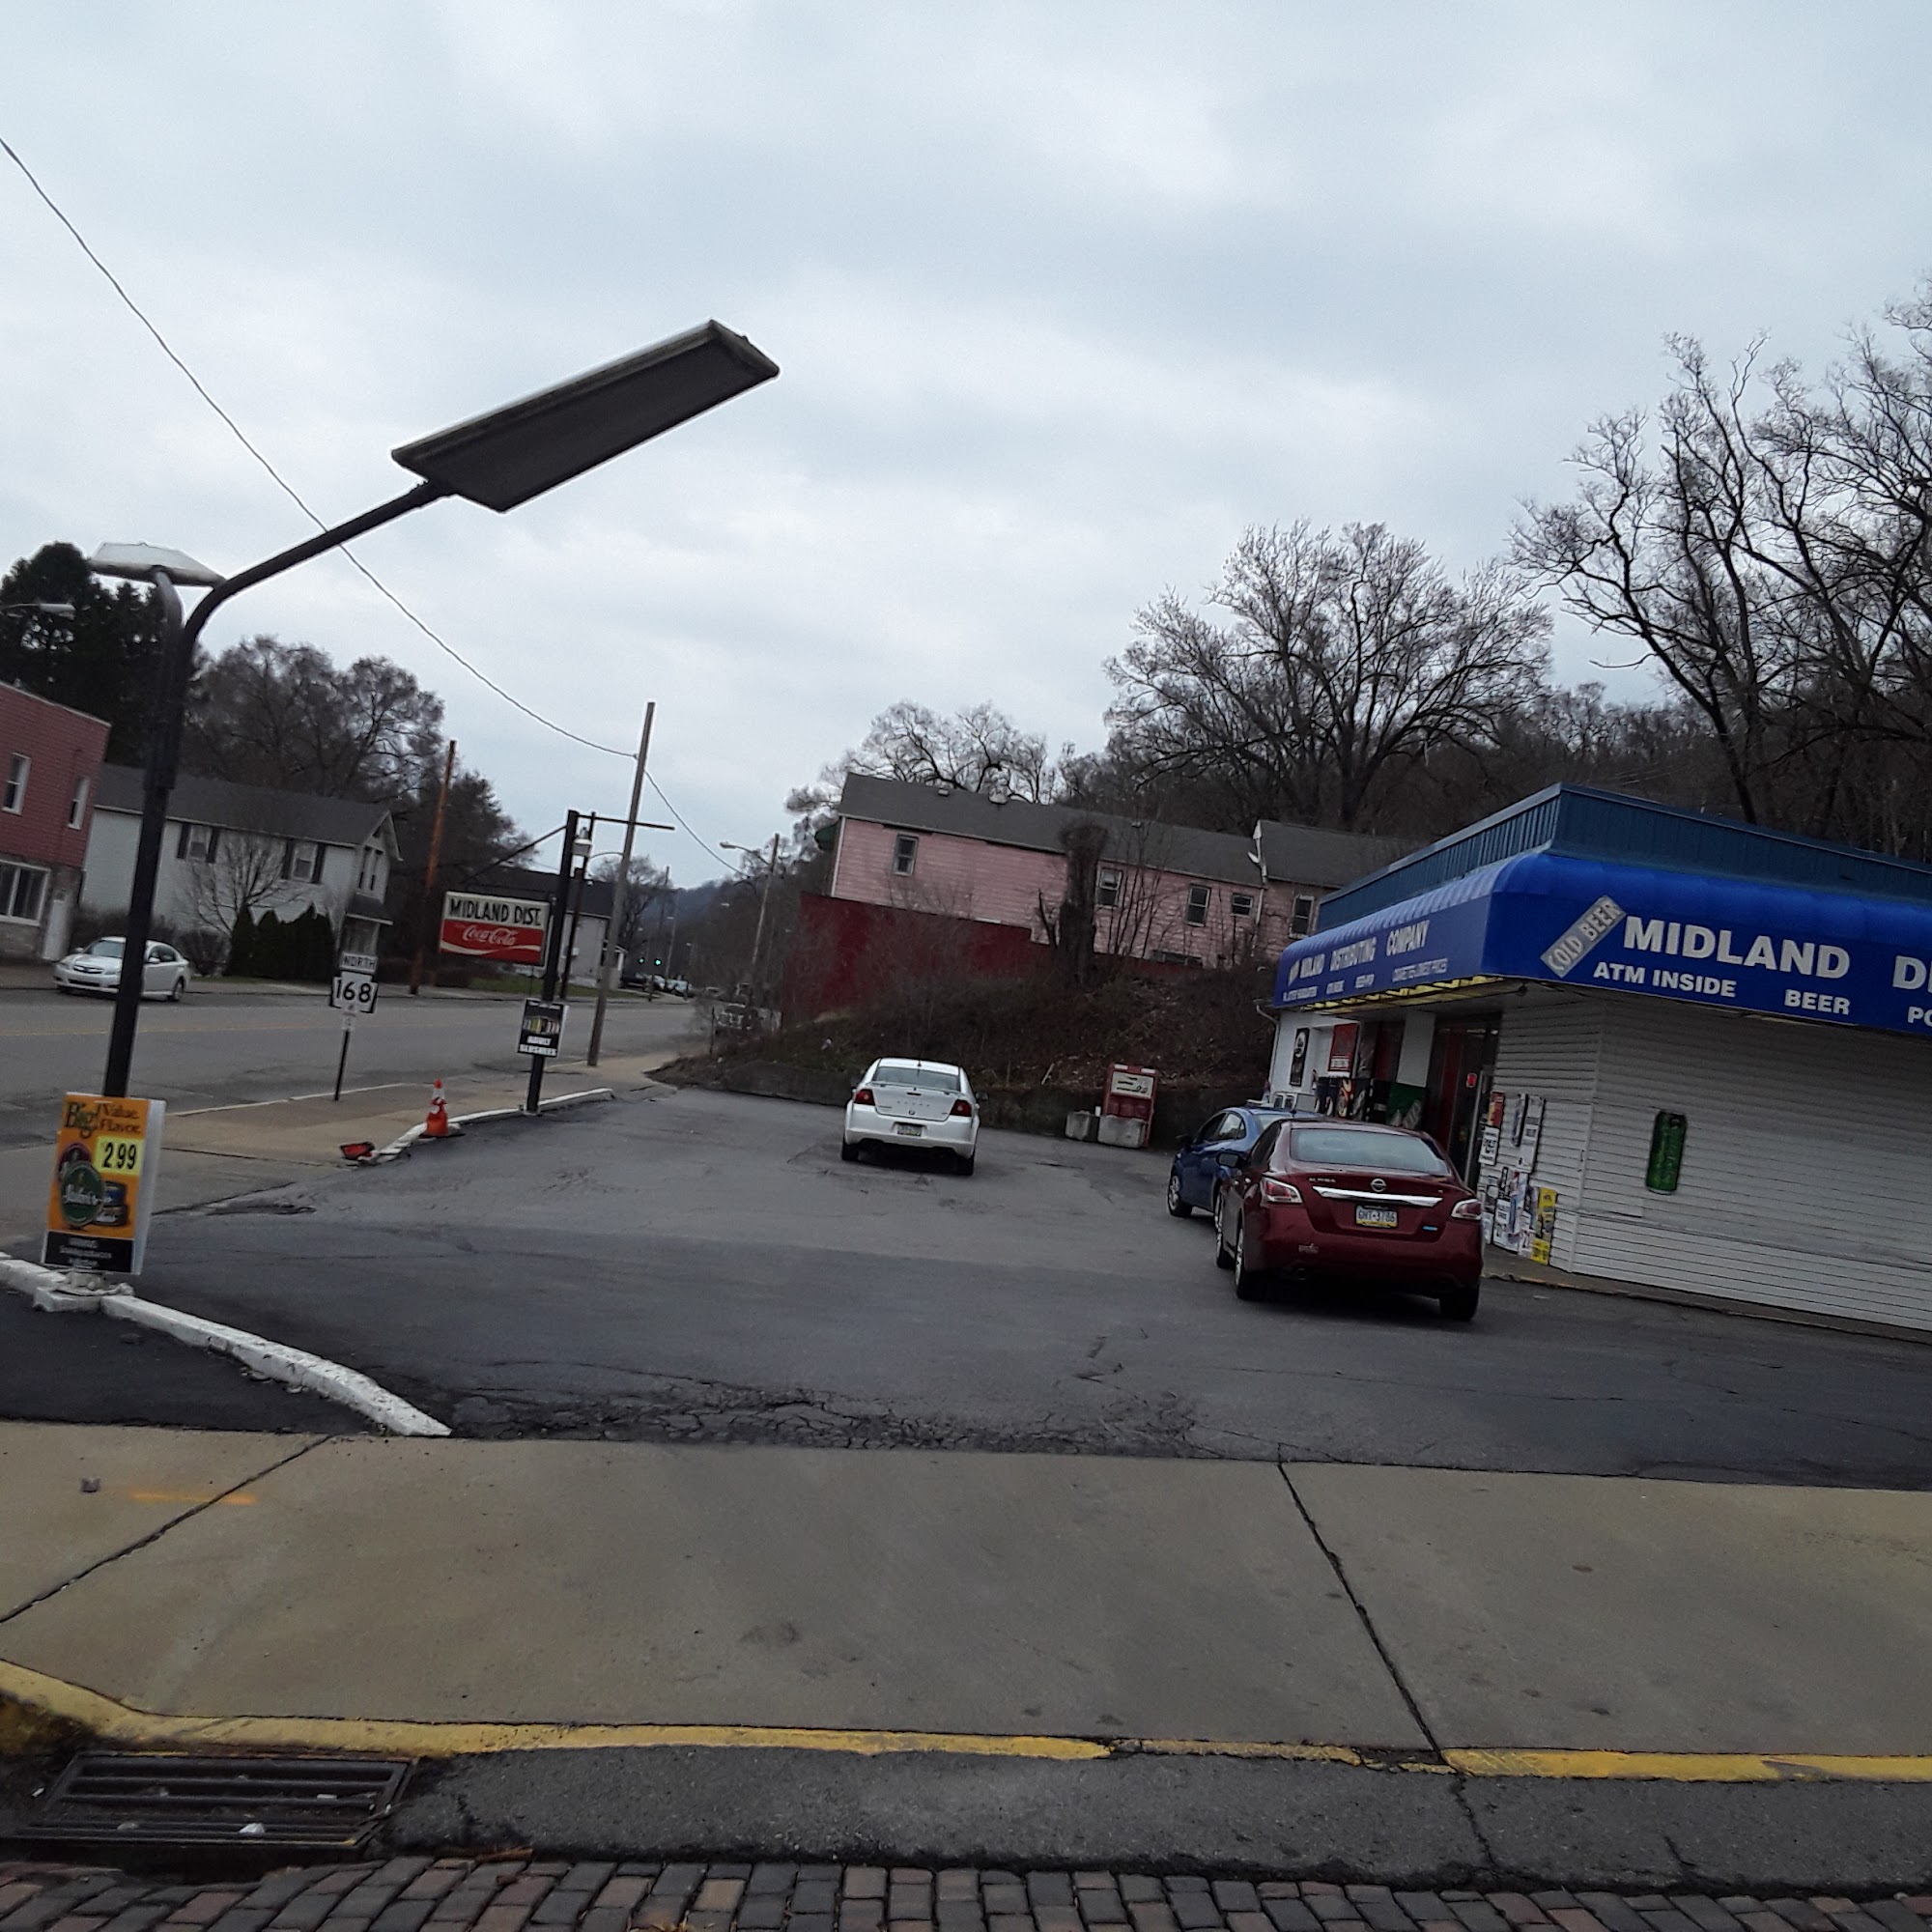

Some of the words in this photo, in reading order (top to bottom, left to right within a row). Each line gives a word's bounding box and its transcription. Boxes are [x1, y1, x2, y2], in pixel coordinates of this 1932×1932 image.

[450, 898, 509, 923] MIDLAND
[1386, 920, 1430, 956] COMPANY
[1548, 934, 1582, 971] COLD
[1578, 901, 1621, 942] BEER
[343, 954, 376, 970] NORTH
[1623, 915, 1850, 980] MIDLAND
[1892, 954, 1932, 993] D
[336, 979, 371, 1003] 168
[1593, 961, 1646, 984] ATM
[1652, 969, 1737, 998] INSIDE
[1784, 989, 1851, 1015] BEER
